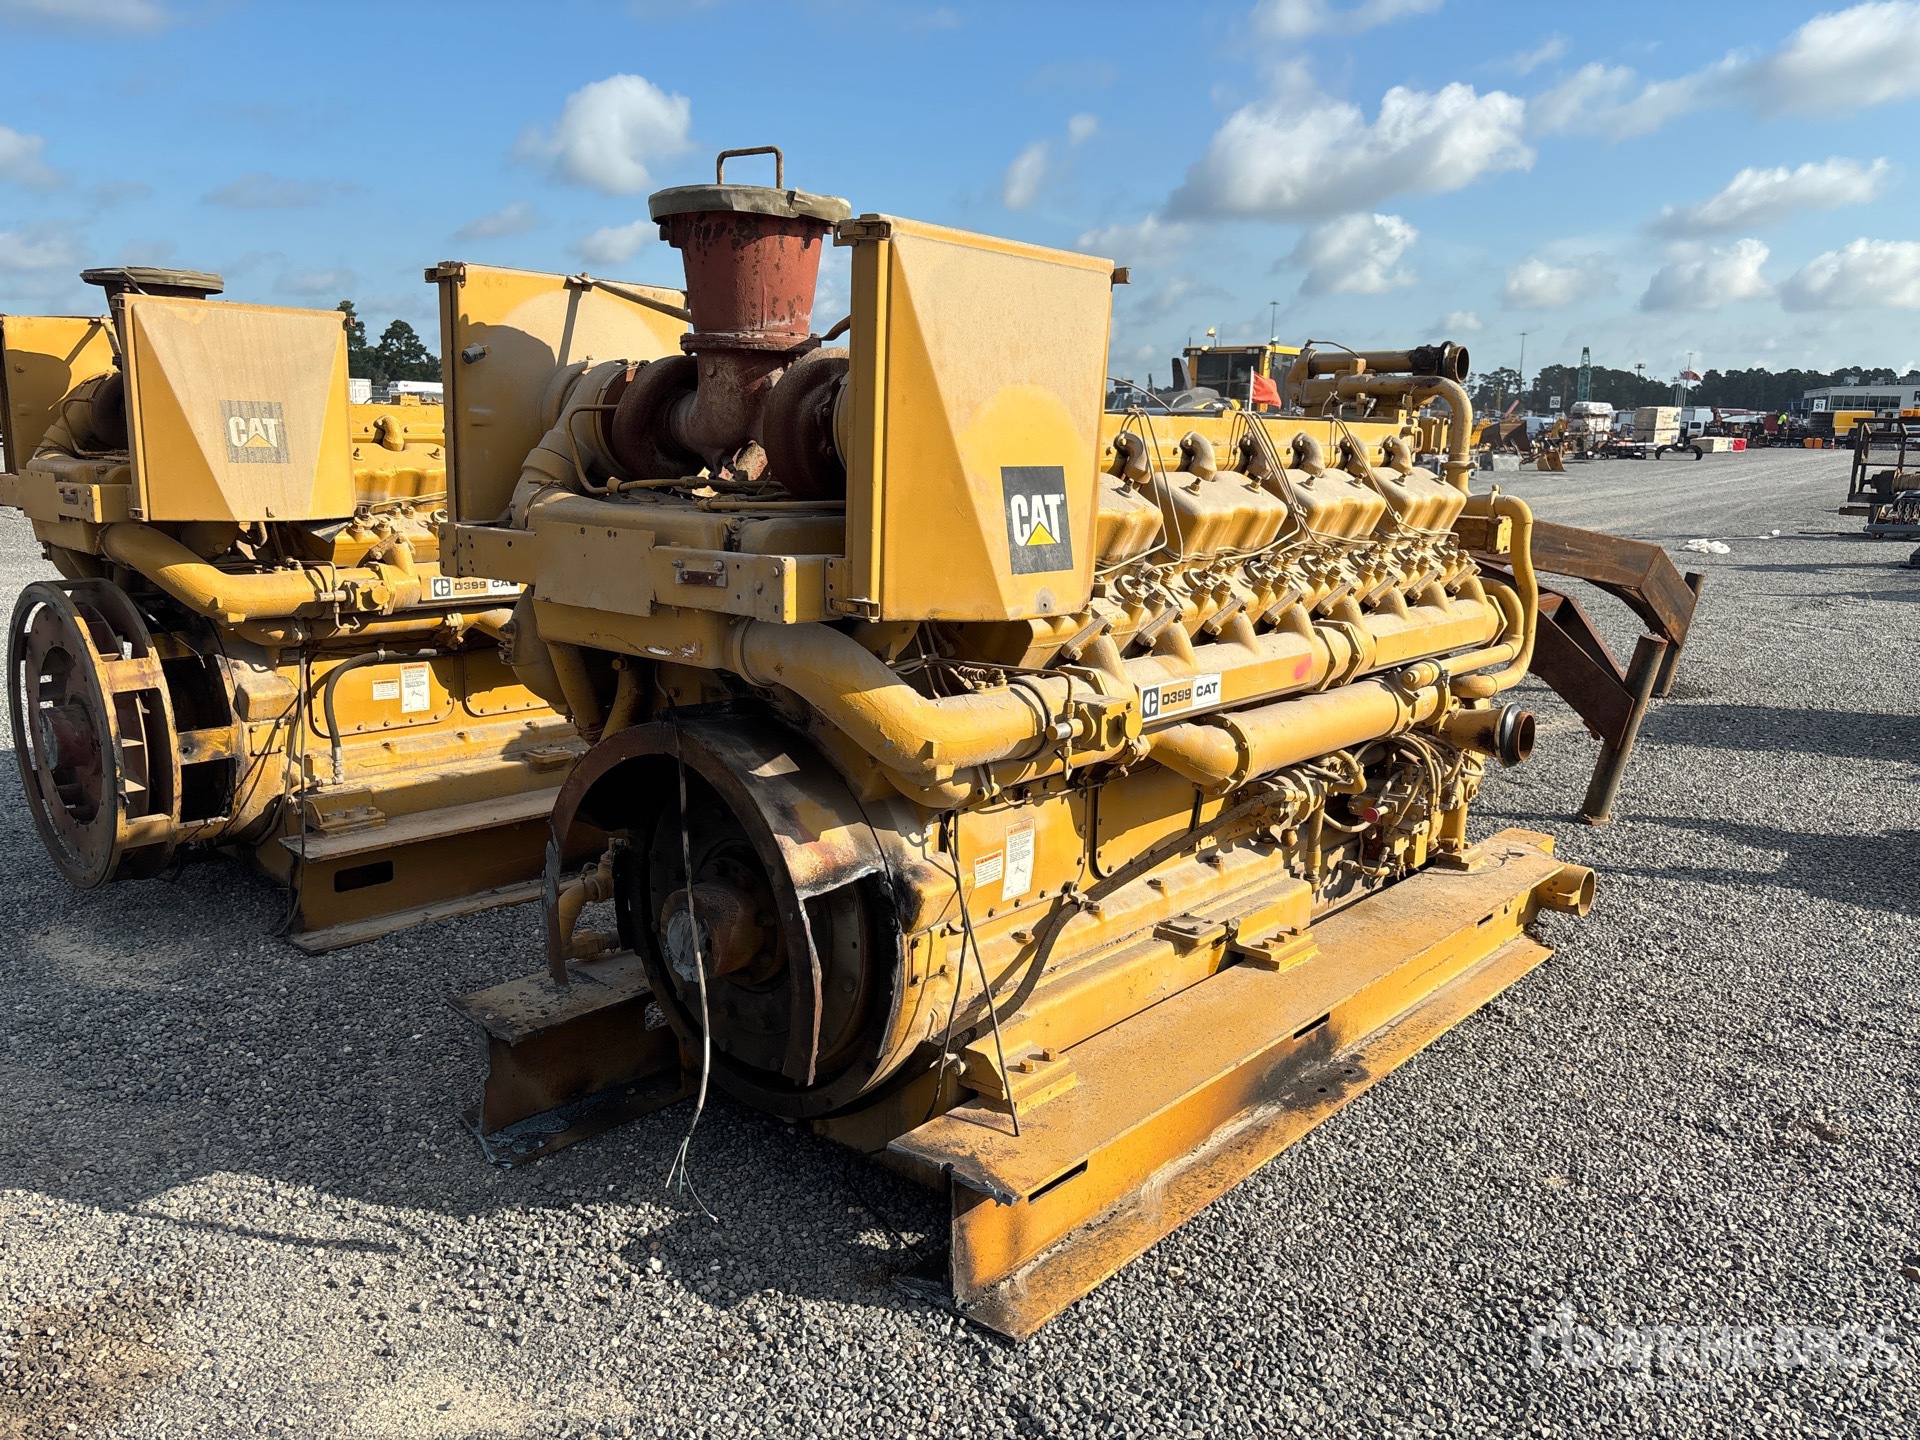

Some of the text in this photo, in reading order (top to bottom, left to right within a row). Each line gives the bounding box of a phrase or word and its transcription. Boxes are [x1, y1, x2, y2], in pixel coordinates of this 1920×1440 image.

[1815, 402, 1824, 410] 51
[228, 416, 279, 448] CAT
[1010, 493, 1062, 547] CAT
[454, 581, 487, 590] D399
[492, 579, 518, 588] CA
[1162, 688, 1191, 705] D399
[1196, 682, 1218, 697] CAT
